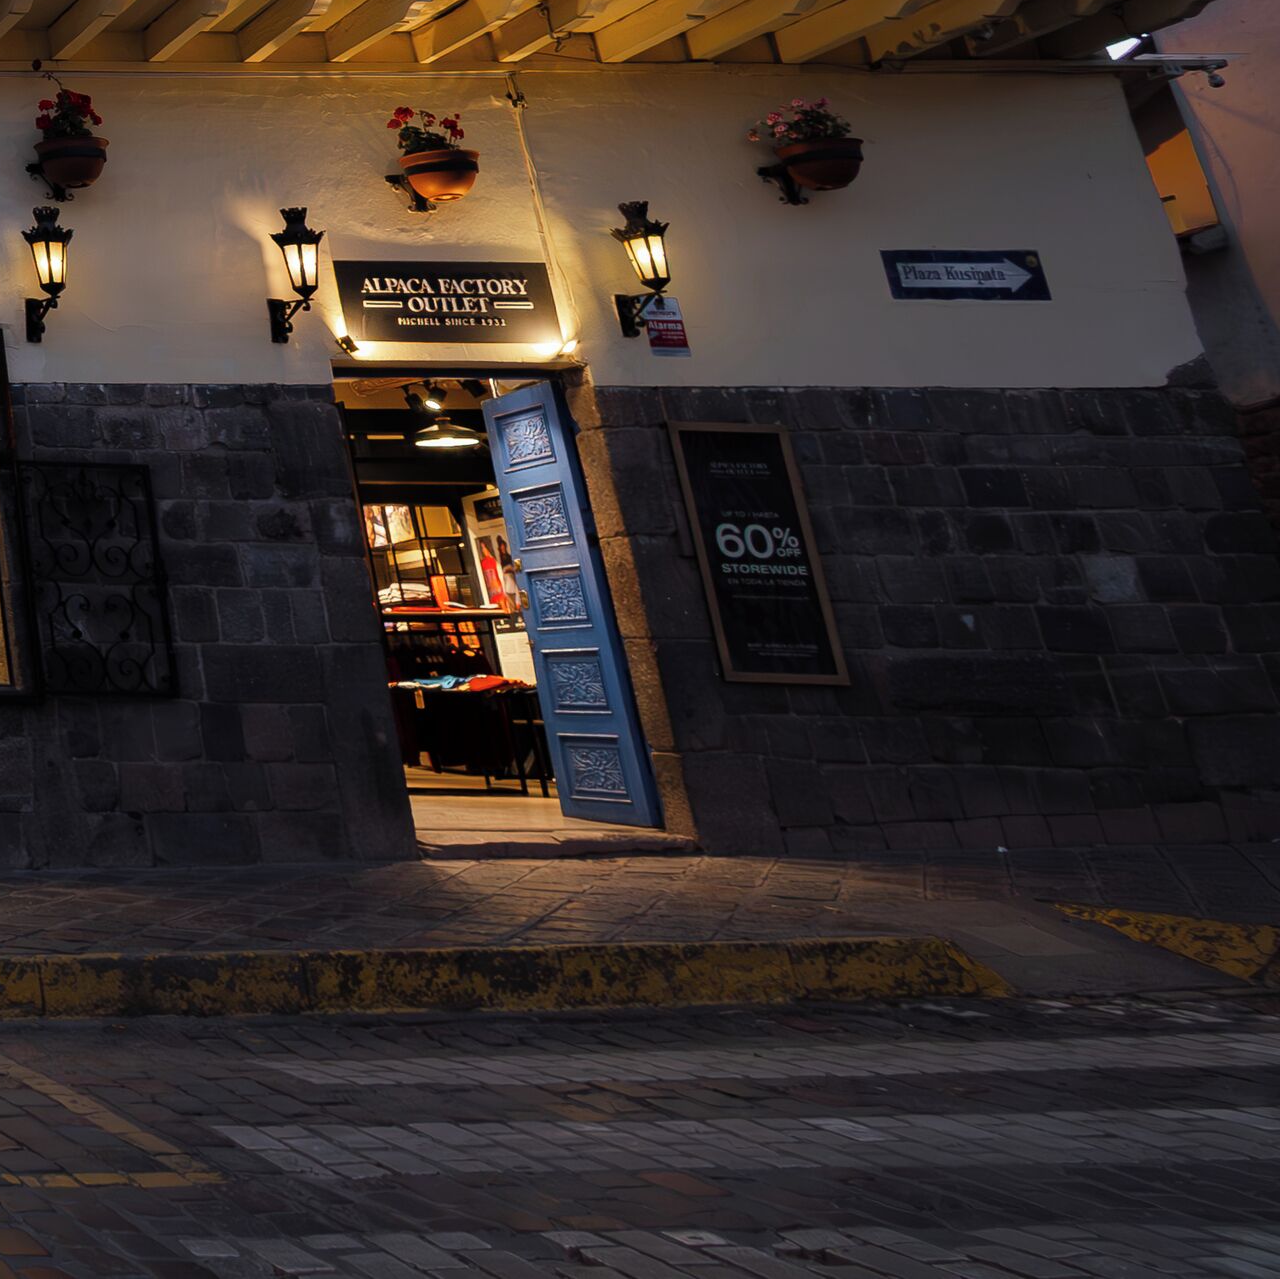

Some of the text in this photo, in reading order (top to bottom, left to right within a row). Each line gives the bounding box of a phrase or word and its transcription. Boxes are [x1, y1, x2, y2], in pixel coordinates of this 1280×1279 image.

[903, 265, 1006, 285] Plaza Kusipata
[361, 277, 528, 295] ALPACA FACTORY
[407, 297, 490, 313] OUTLET
[397, 317, 507, 327] MICHELL SINCE 1931
[648, 320, 683, 330] Alarma
[715, 523, 800, 559] 60%
[776, 548, 802, 558] OFF
[721, 563, 808, 576] STOREWIDE
